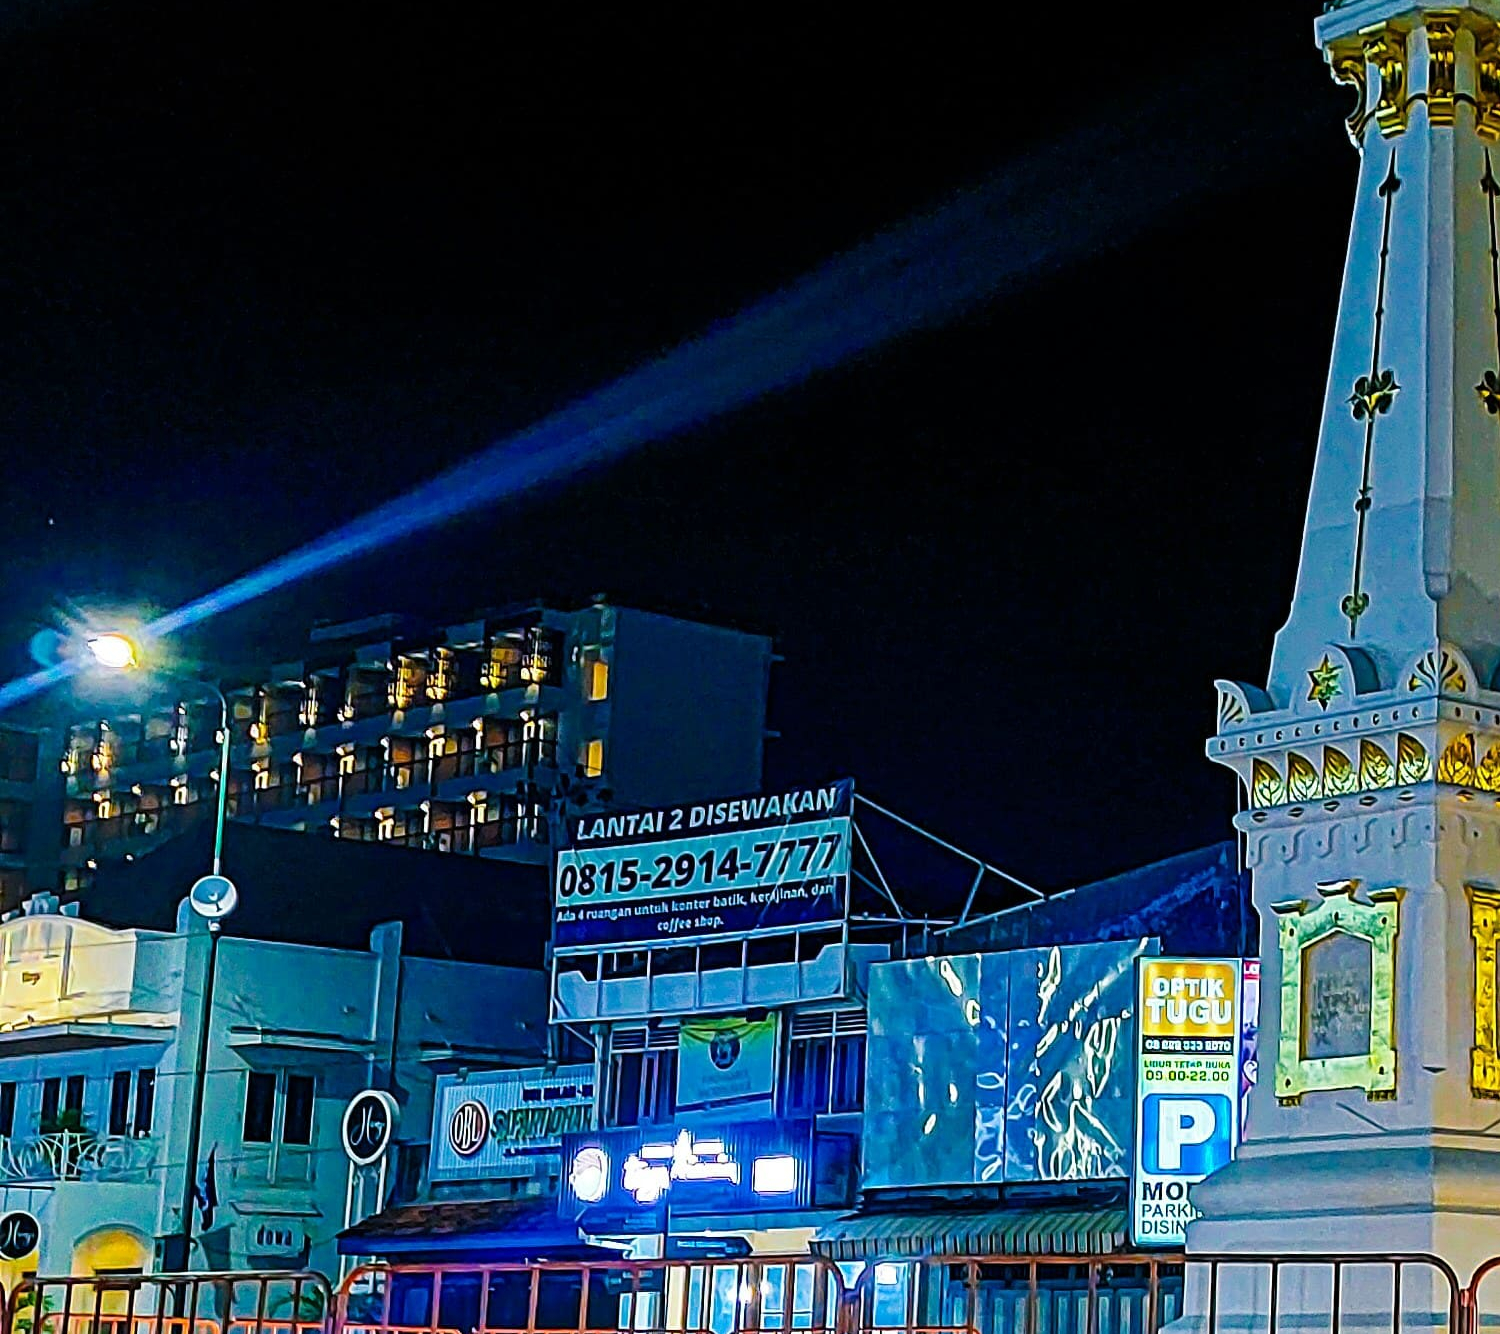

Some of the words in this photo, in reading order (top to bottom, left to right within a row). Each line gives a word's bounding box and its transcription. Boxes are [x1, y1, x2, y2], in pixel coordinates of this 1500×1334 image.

[577, 812, 663, 840] LANTAI
[669, 810, 682, 831] 2
[689, 787, 837, 829] DISEWAKAN
[559, 833, 842, 898] 0815-2914-7777
[586, 907, 632, 921] ruangan
[634, 902, 669, 916] untuk
[671, 899, 710, 913] konter
[811, 883, 834, 898] dan
[657, 919, 692, 933] coffee
[1152, 977, 1225, 998] OPTIK
[1145, 998, 1232, 1025] TUGU
[1158, 1099, 1216, 1170] P
